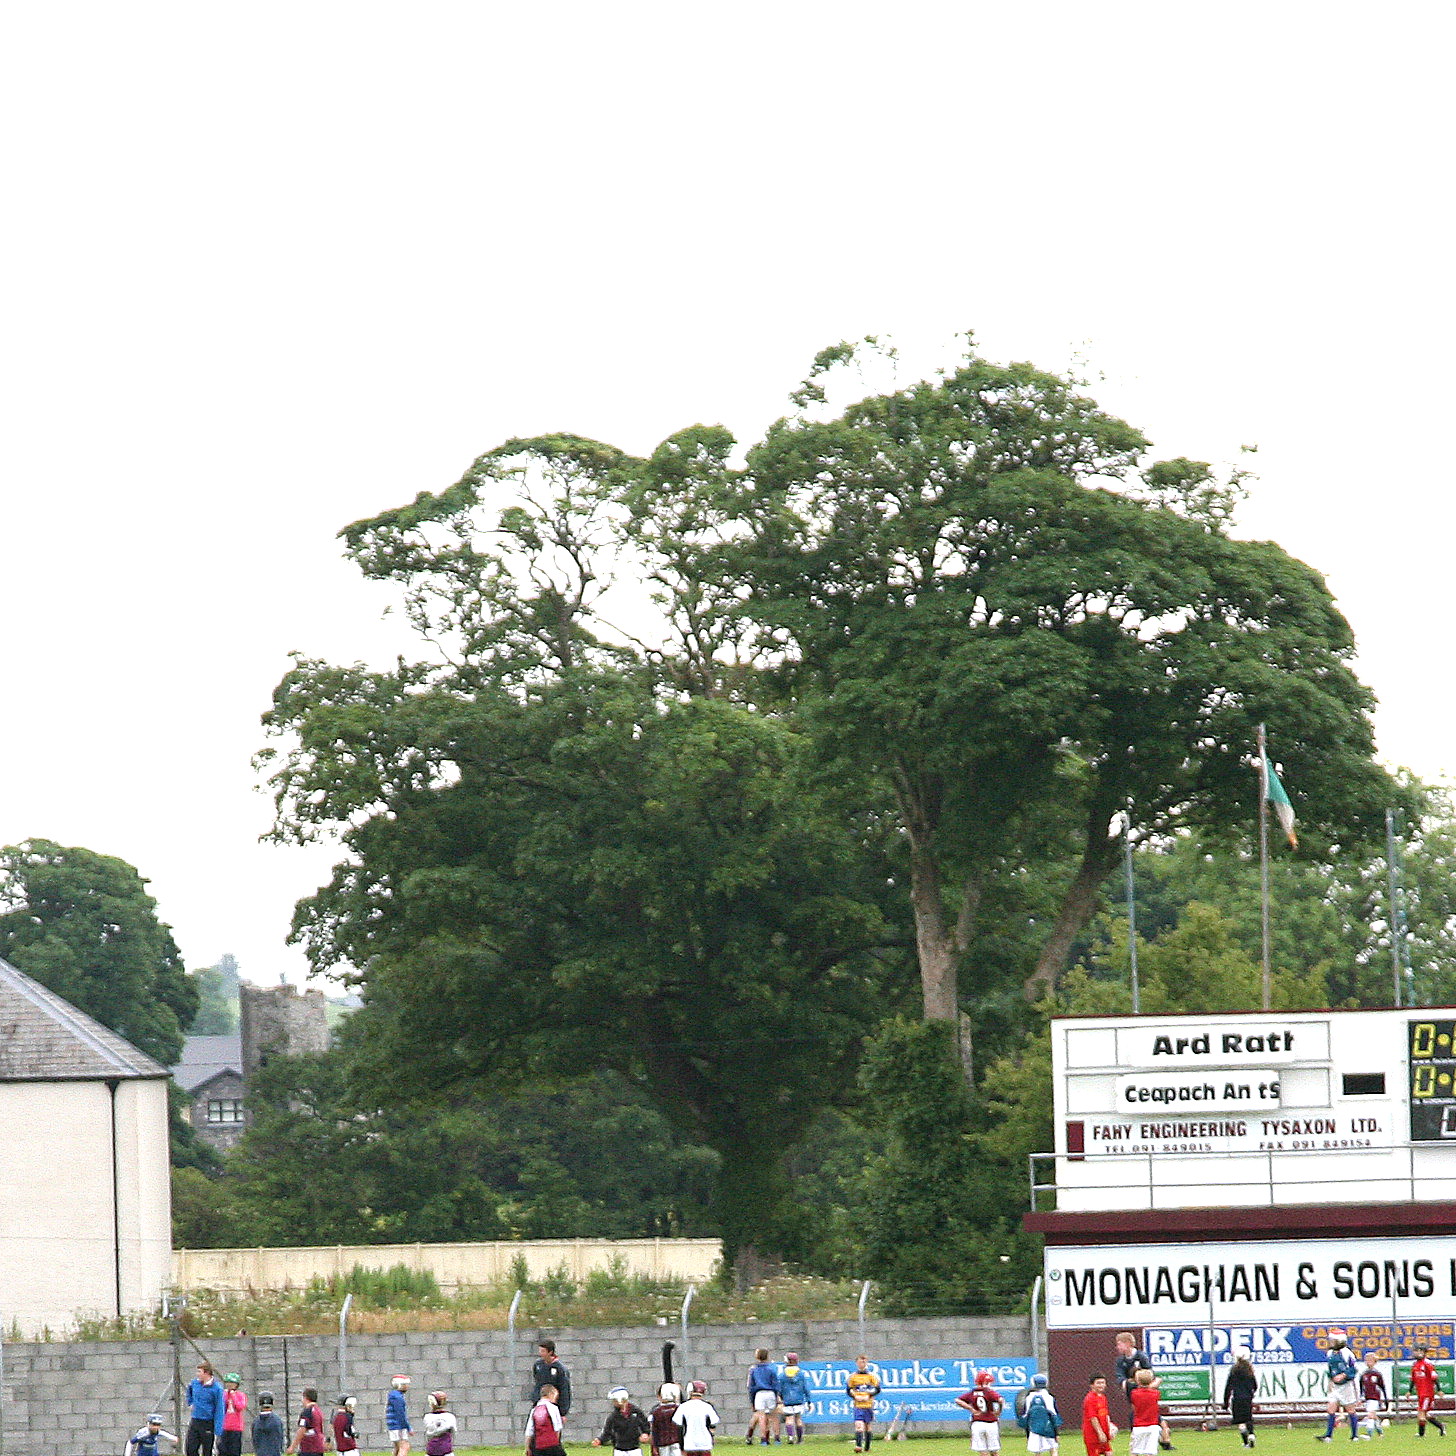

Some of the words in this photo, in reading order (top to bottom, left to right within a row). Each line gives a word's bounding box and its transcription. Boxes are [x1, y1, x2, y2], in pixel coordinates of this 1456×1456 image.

[1152, 1033, 1210, 1056] Ard
[1124, 1083, 1216, 1104] Ceapach
[1223, 1083, 1251, 1100] An
[1093, 1124, 1132, 1140] FAHY
[1141, 1121, 1247, 1139] ENGINEERING
[1261, 1119, 1336, 1136] TYSAXON
[1351, 1118, 1382, 1133] LTD.
[1064, 1262, 1280, 1306] MONAGHAN
[1296, 1262, 1319, 1300] &
[1333, 1259, 1434, 1299] SONS
[1150, 1353, 1203, 1365] GALWAY
